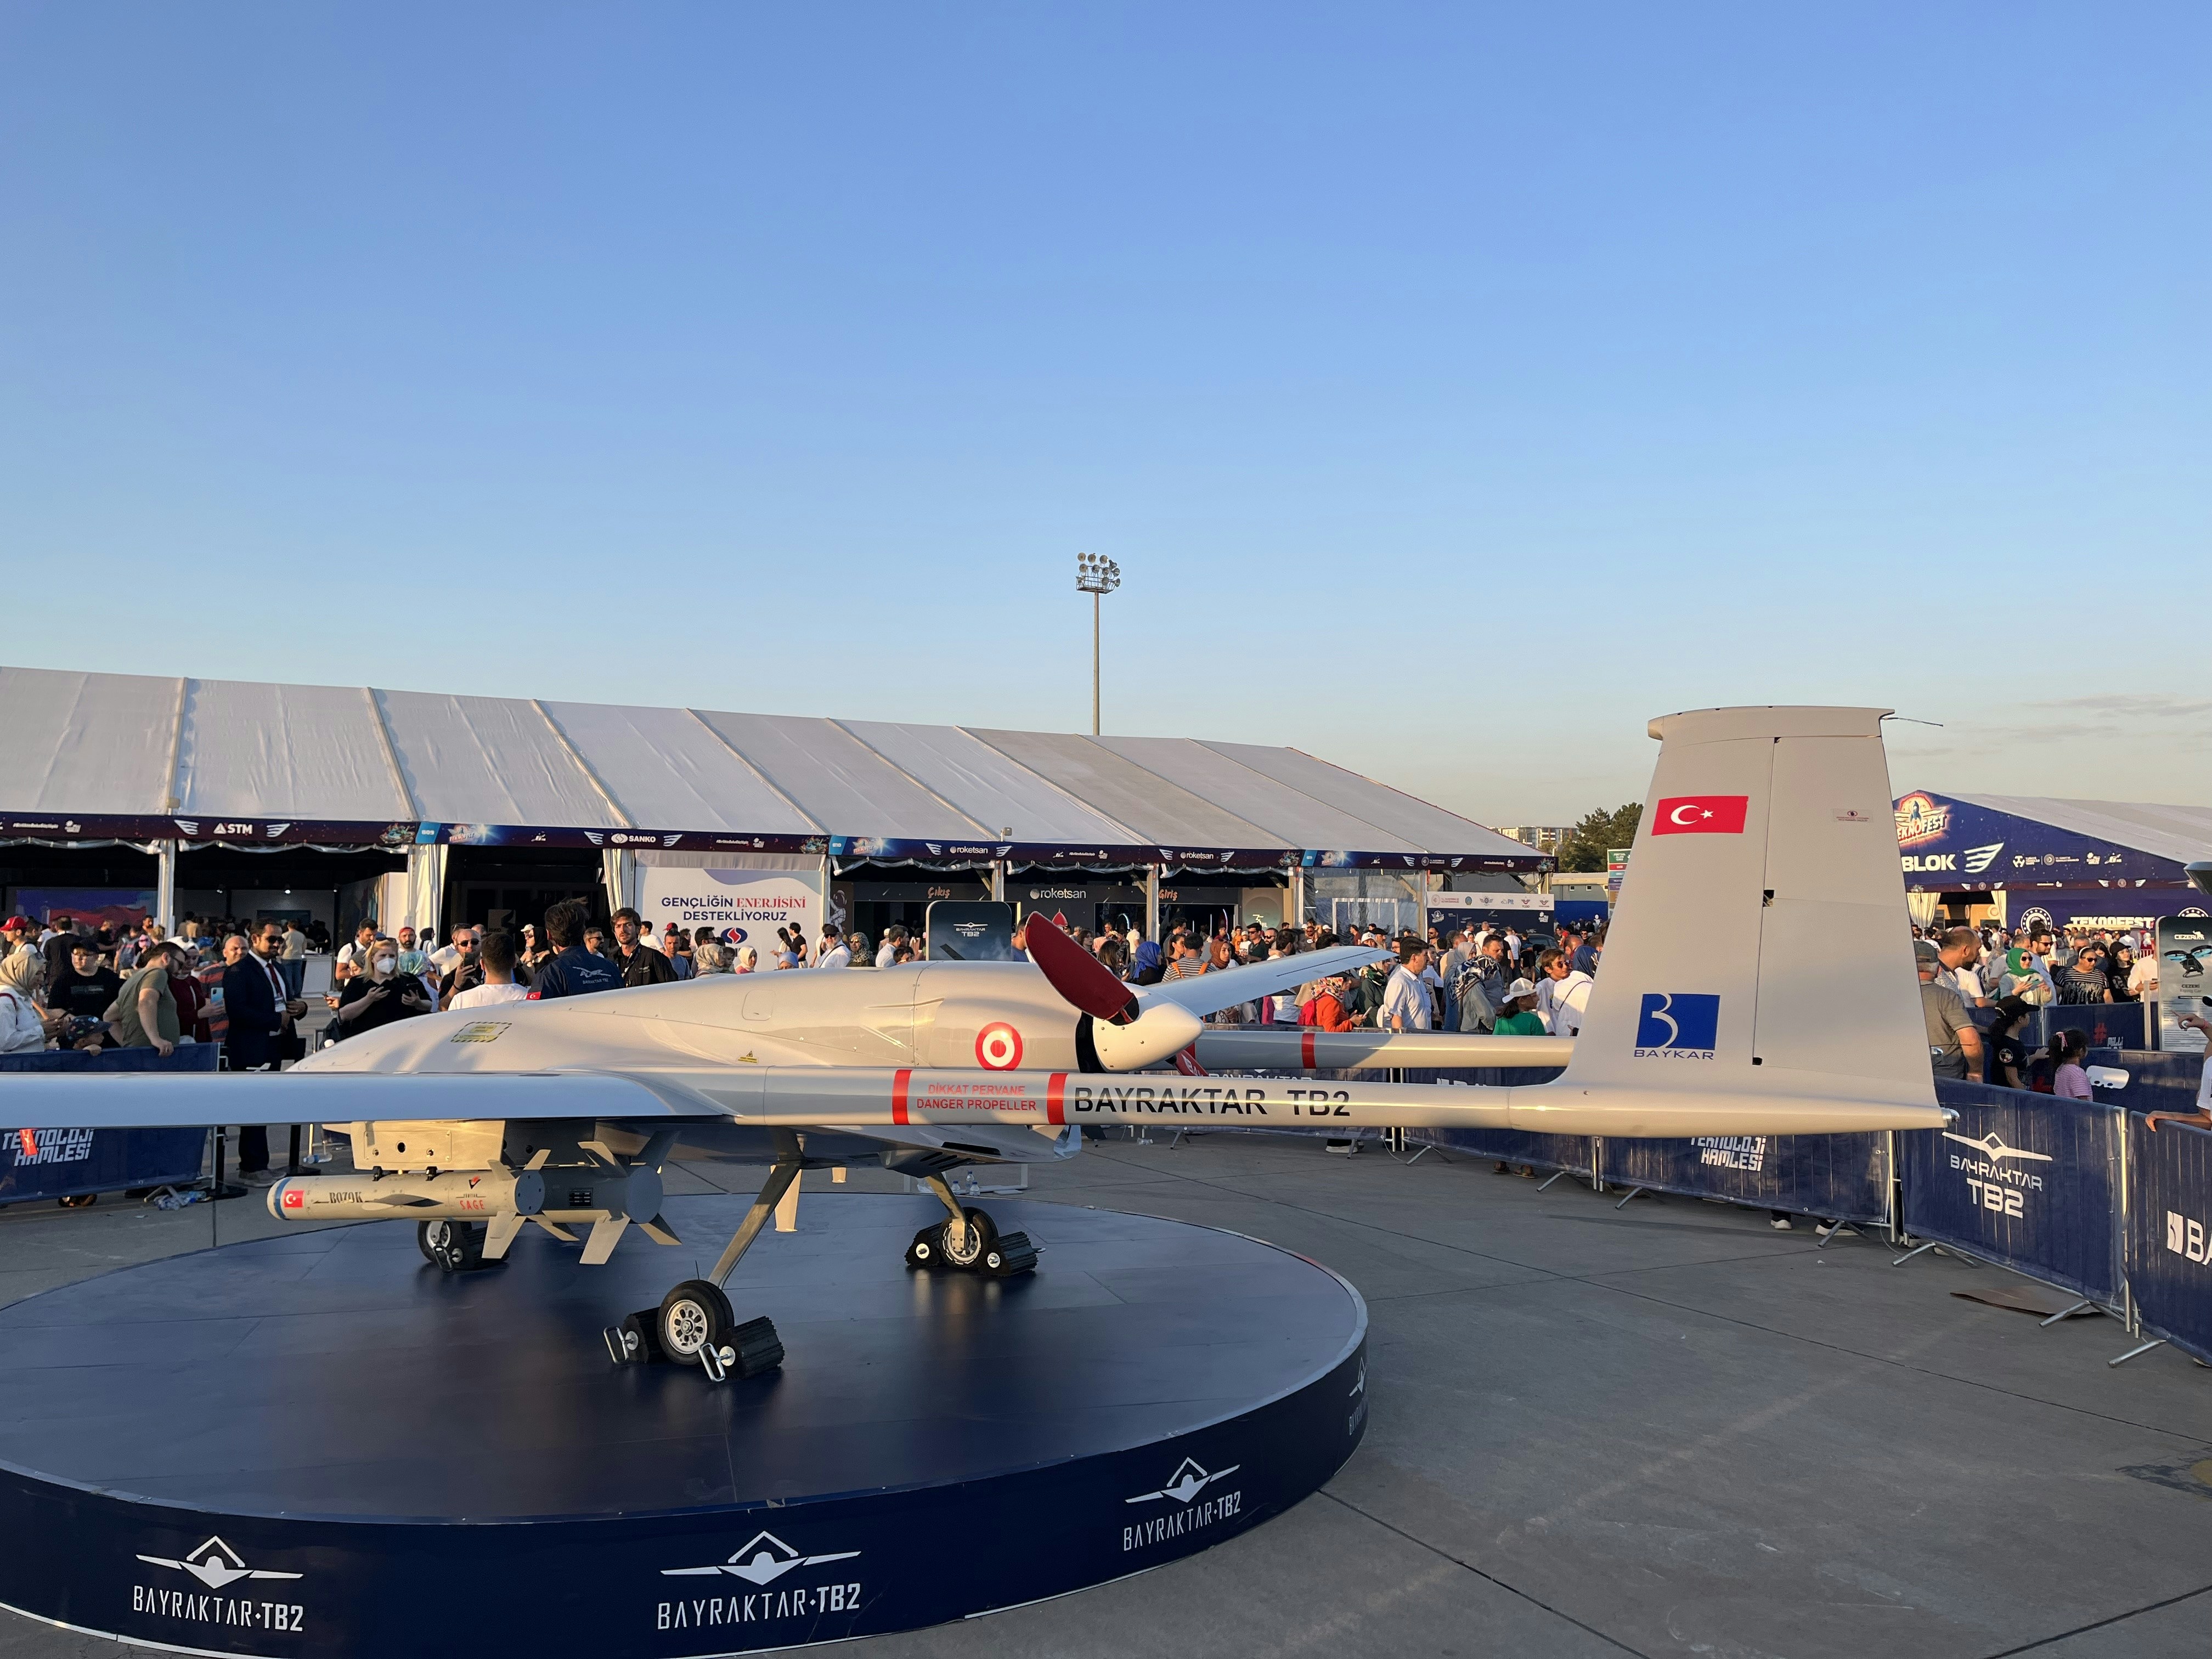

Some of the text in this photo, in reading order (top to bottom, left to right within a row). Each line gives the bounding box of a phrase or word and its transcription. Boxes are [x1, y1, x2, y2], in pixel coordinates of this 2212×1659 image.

[227, 823, 253, 834] STM
[1896, 814, 1946, 841] EKNOFEST
[628, 834, 656, 843] SANKO
[957, 846, 988, 854] roketsan
[1186, 851, 1214, 860] roketsan
[1901, 854, 1957, 872] BLOK
[1040, 888, 1086, 899] roketsan
[661, 895, 806, 909] GENÇLİĞİN ENERJİSİNİ
[683, 909, 787, 921] DESTEKLİYORUZ
[1634, 1049, 1714, 1060] BAYKAR
[928, 1082, 1025, 1096] DİKKAT PERVANE
[917, 1098, 1037, 1111] DANGER PROPELLER
[1074, 1087, 1351, 1117] BAYRAKTAR TB2
[2, 1128, 94, 1150] TENOLOJİ
[1701, 1147, 1763, 1171] HAMLESİ
[1950, 1154, 2042, 1192] BAYRAKTAR
[329, 1192, 364, 1204] BOZOK
[1966, 1177, 2024, 1219] TB2
[460, 1199, 486, 1211] SAGE
